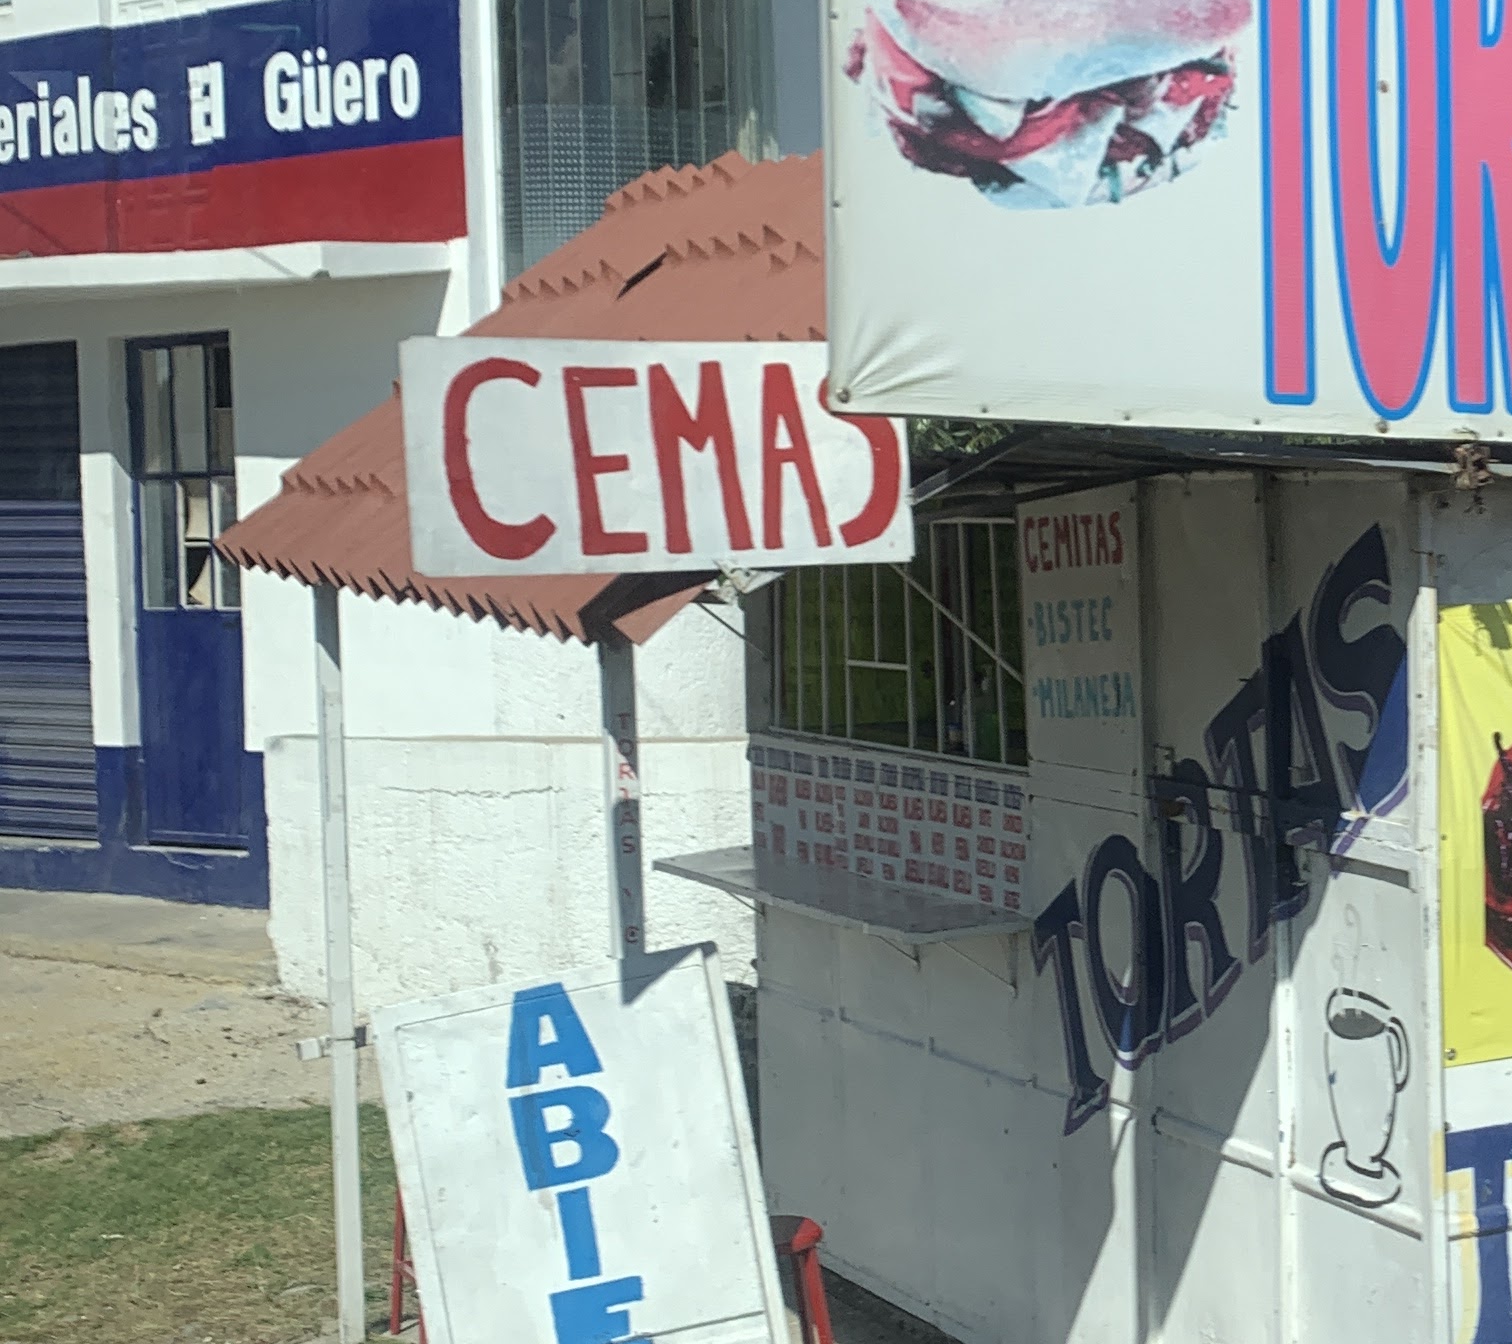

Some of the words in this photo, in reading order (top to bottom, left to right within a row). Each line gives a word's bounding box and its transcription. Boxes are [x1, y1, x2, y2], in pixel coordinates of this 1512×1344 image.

[263, 46, 420, 133] Güero
[443, 356, 902, 561] CEMAS
[1023, 510, 1123, 573] CEMITAS
[1033, 522, 1409, 1137] TORTAS
